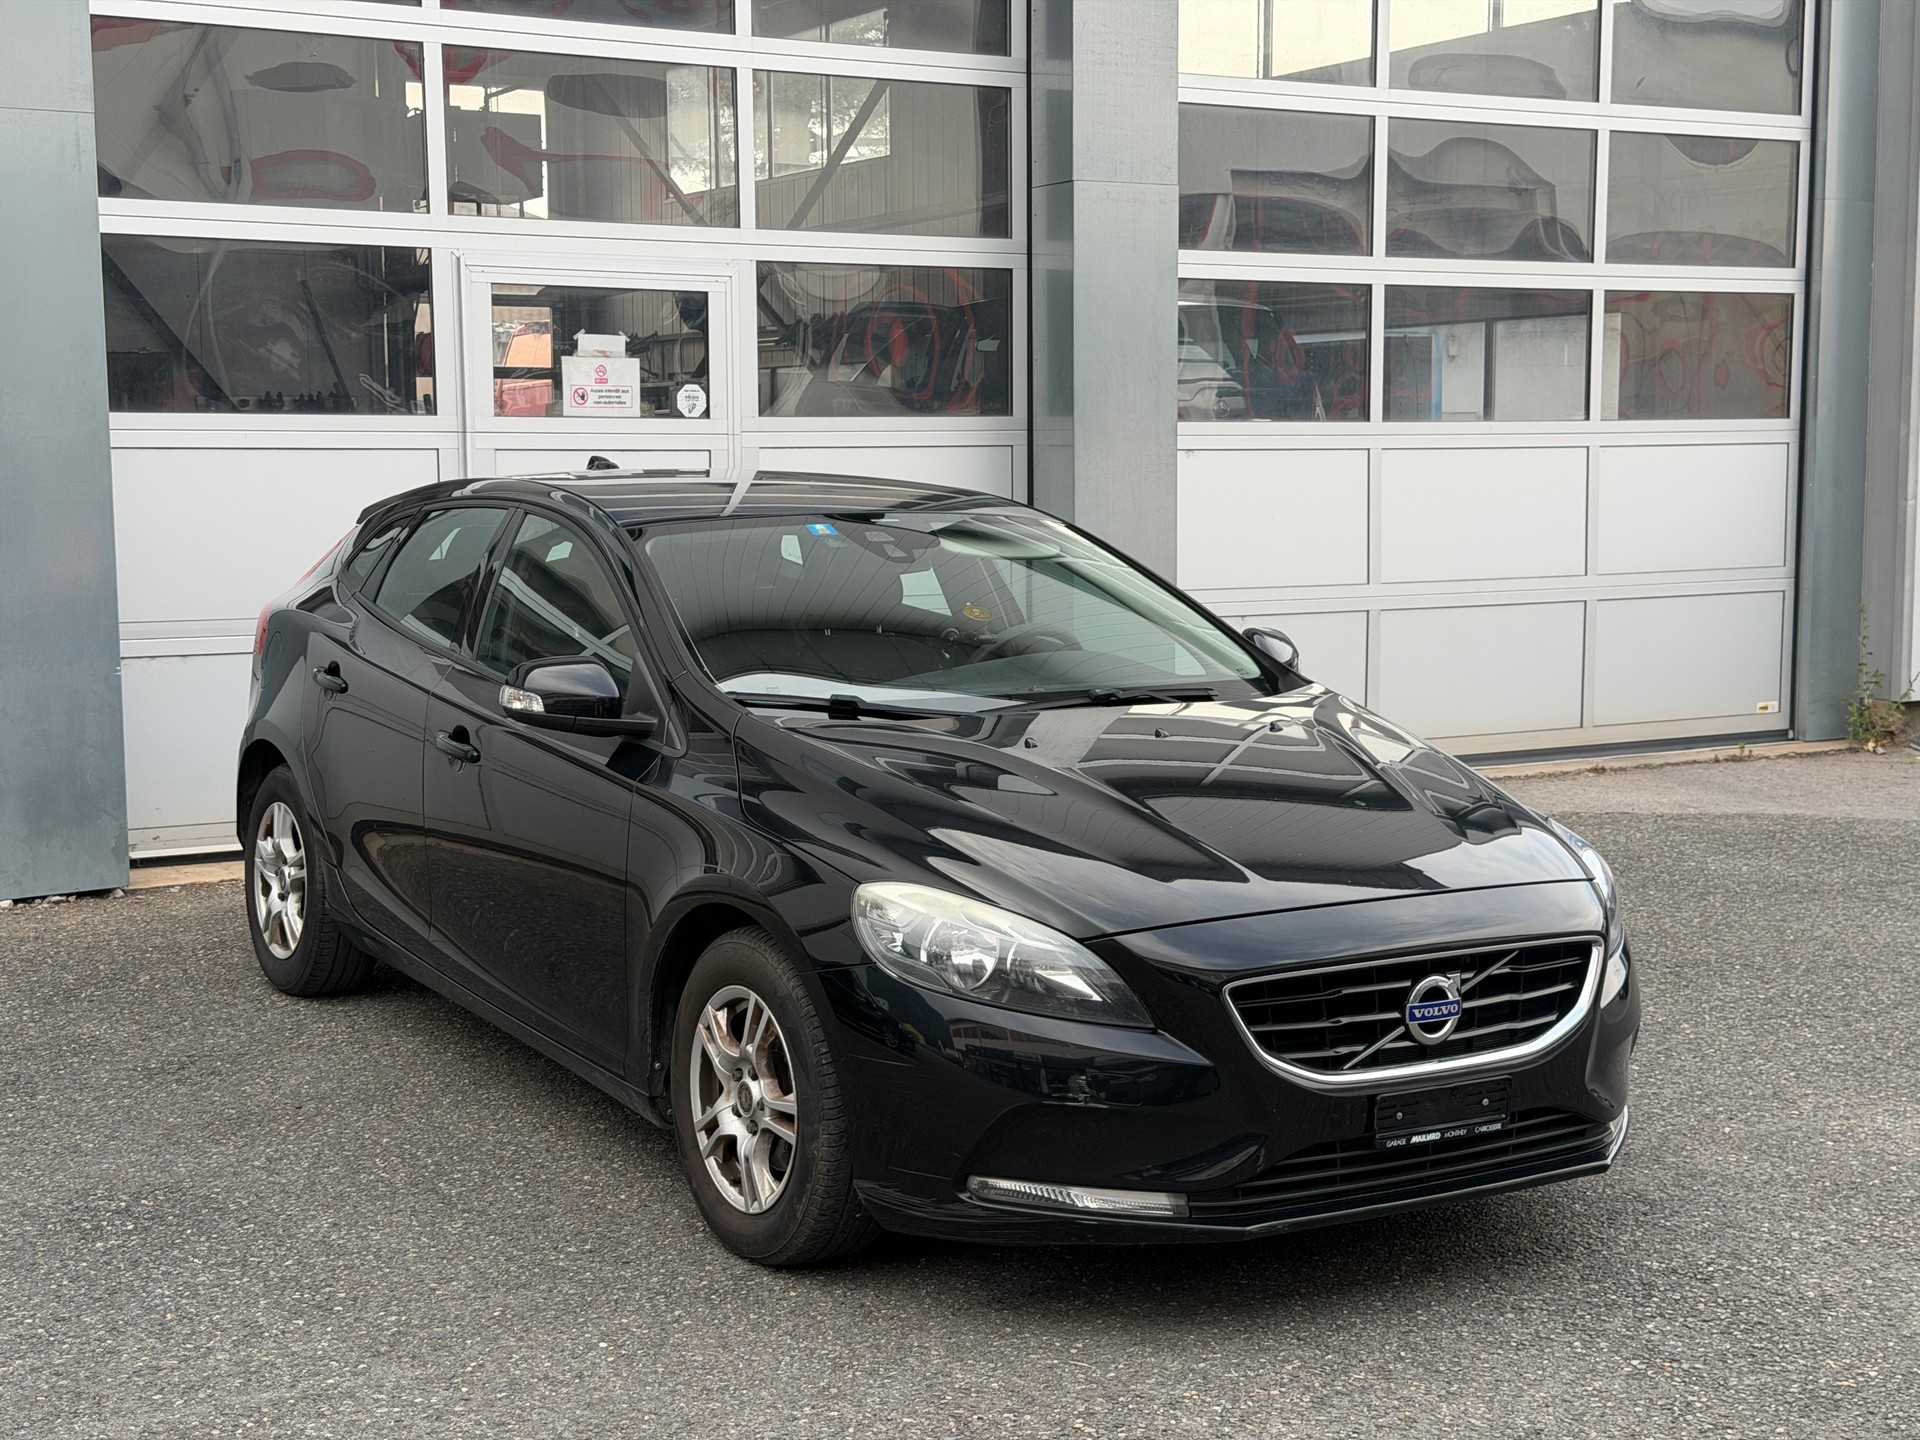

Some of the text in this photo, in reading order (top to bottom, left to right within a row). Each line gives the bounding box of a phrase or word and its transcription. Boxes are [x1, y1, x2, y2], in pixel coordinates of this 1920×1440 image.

[1411, 1003, 1458, 1018] VOLVO
[1386, 1138, 1407, 1148] GARAGE
[1444, 1129, 1468, 1138] MONTHEY
